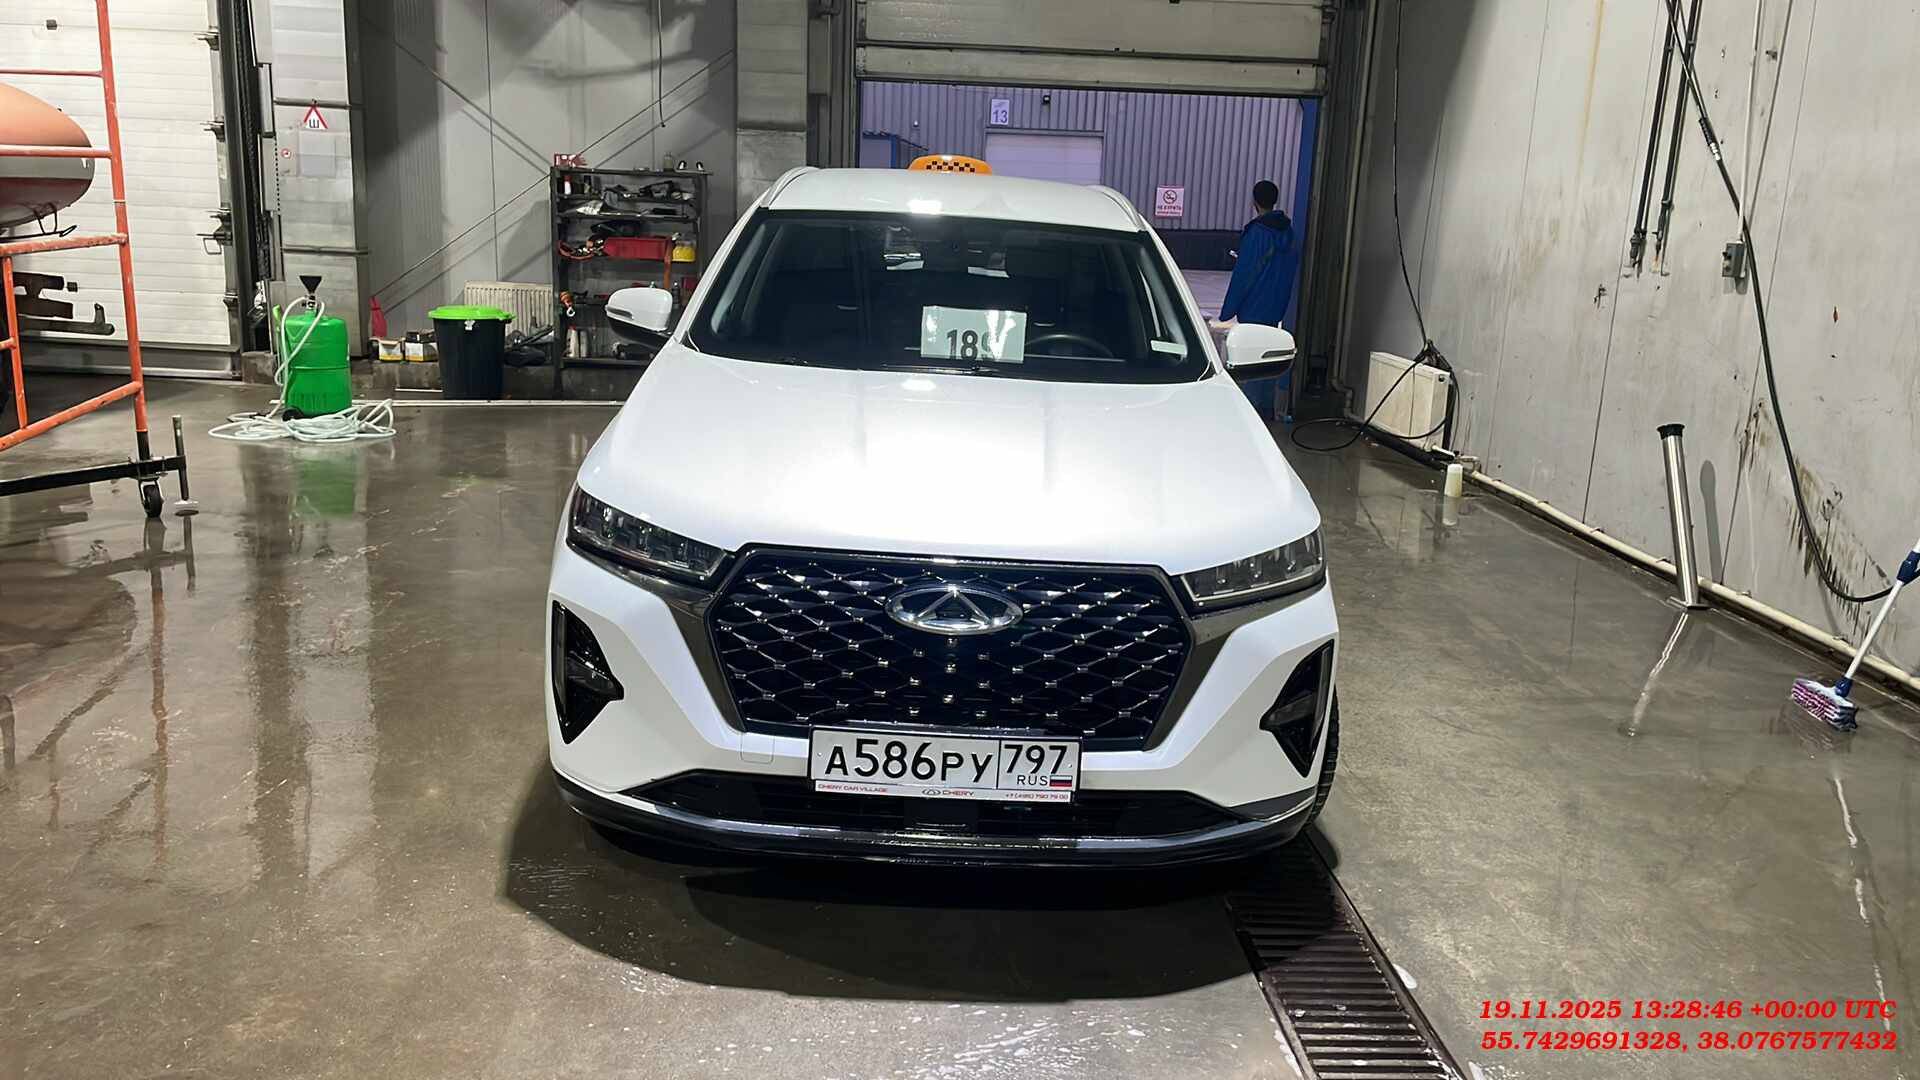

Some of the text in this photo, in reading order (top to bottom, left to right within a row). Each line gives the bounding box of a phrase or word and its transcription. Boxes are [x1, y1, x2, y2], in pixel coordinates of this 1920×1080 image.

[993, 110, 1007, 123] 13
[1004, 744, 1068, 774] 797
[1016, 775, 1048, 786] RUS
